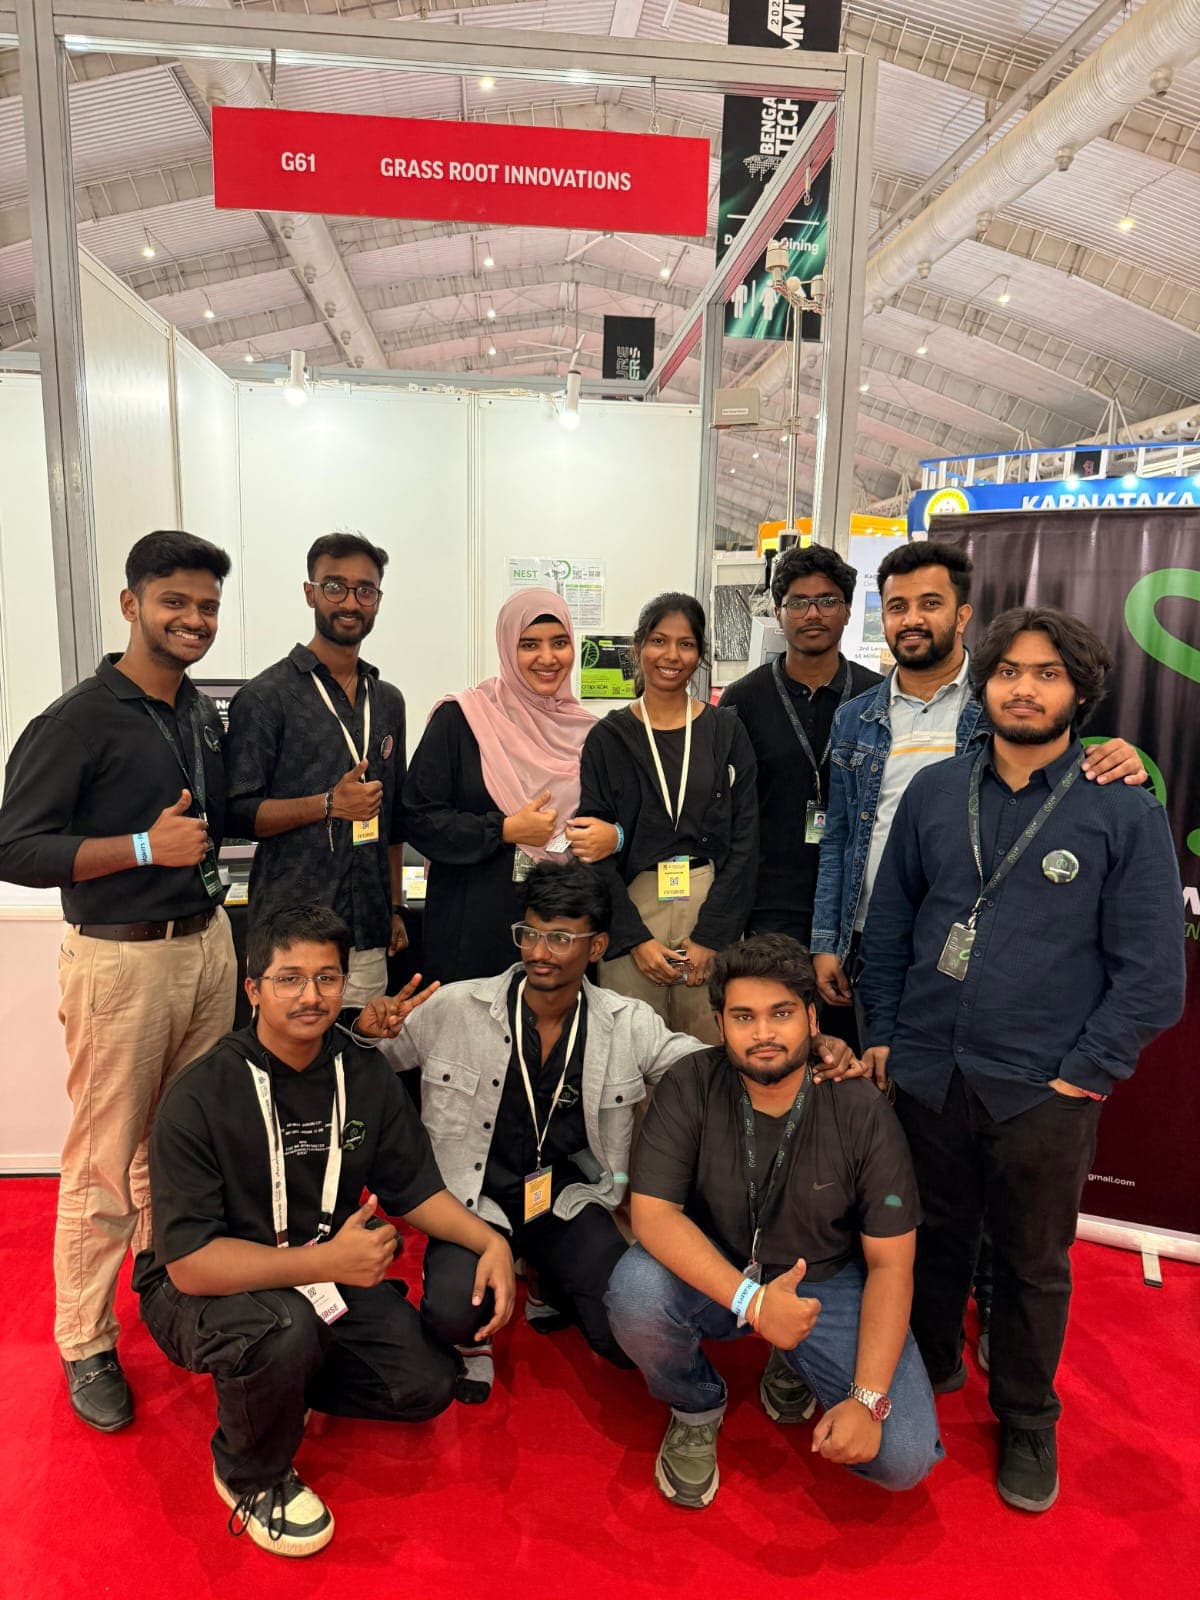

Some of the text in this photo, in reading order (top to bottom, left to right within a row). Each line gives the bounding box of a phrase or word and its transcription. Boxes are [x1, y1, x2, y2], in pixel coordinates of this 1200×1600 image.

[782, 0, 806, 50] MMI
[760, 97, 777, 154] BENGA
[775, 98, 799, 155] TECH
[281, 152, 316, 173] G61
[380, 157, 632, 191] GRASS ROOT INNOVATIONS
[1021, 491, 1195, 509] KARNATAKA
[513, 569, 539, 578] NEST
[1088, 1173, 1136, 1187] gmail.com
